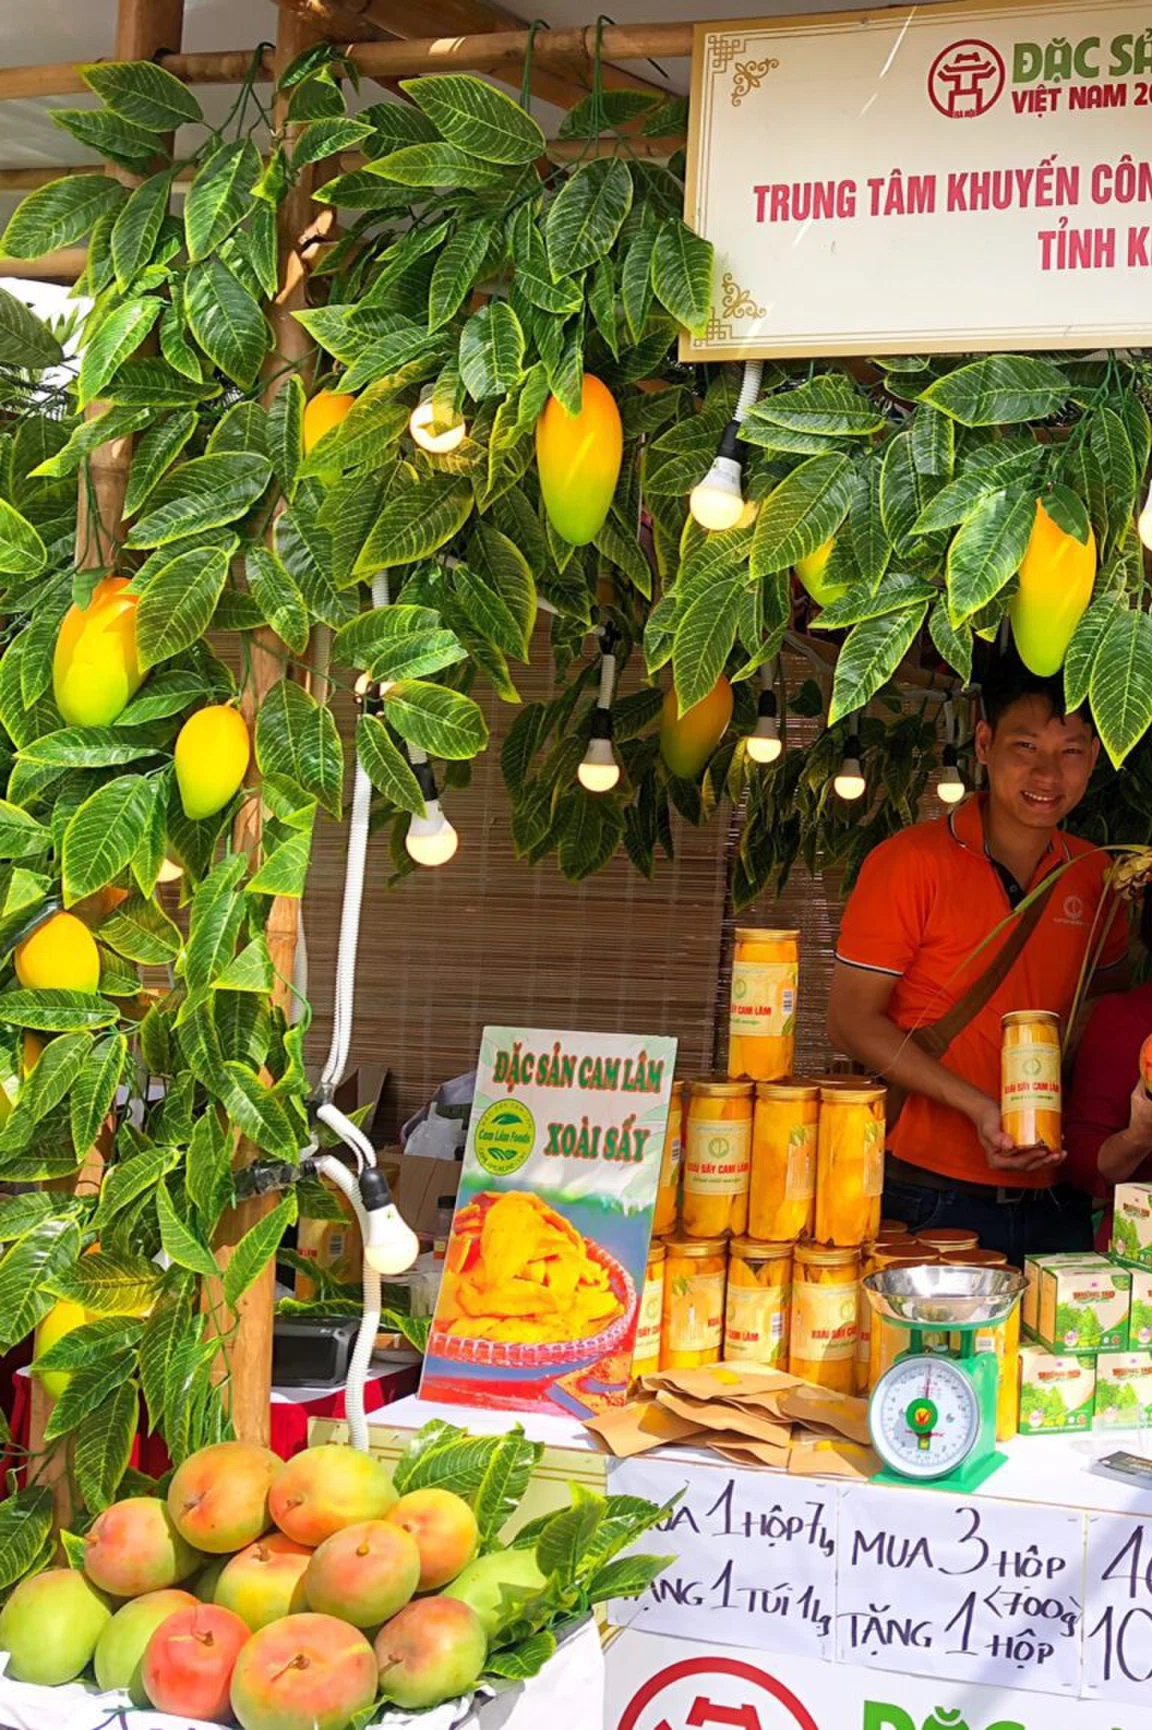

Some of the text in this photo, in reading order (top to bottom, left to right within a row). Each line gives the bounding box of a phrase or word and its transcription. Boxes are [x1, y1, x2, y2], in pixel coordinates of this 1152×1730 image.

[1012, 37, 1100, 83] ĐẶC
[1011, 84, 1062, 118] VIỆT
[1069, 82, 1127, 110] NAM
[753, 179, 857, 223] TRUNG
[867, 168, 936, 217] TÂM
[946, 153, 1080, 212] KHUYẾN
[1038, 216, 1116, 271] TỈNH
[492, 1041, 665, 1094] ĐẶC SẢN CAM LÂM
[543, 1115, 603, 1159] XOÀI
[602, 1113, 651, 1163] SẤY
[706, 1479, 744, 1537] 1
[852, 1529, 934, 1569] MUA
[938, 1506, 989, 1575] 3
[711, 1559, 740, 1610] 1
[836, 1590, 1054, 1669] TẶNG 1 HỘP
